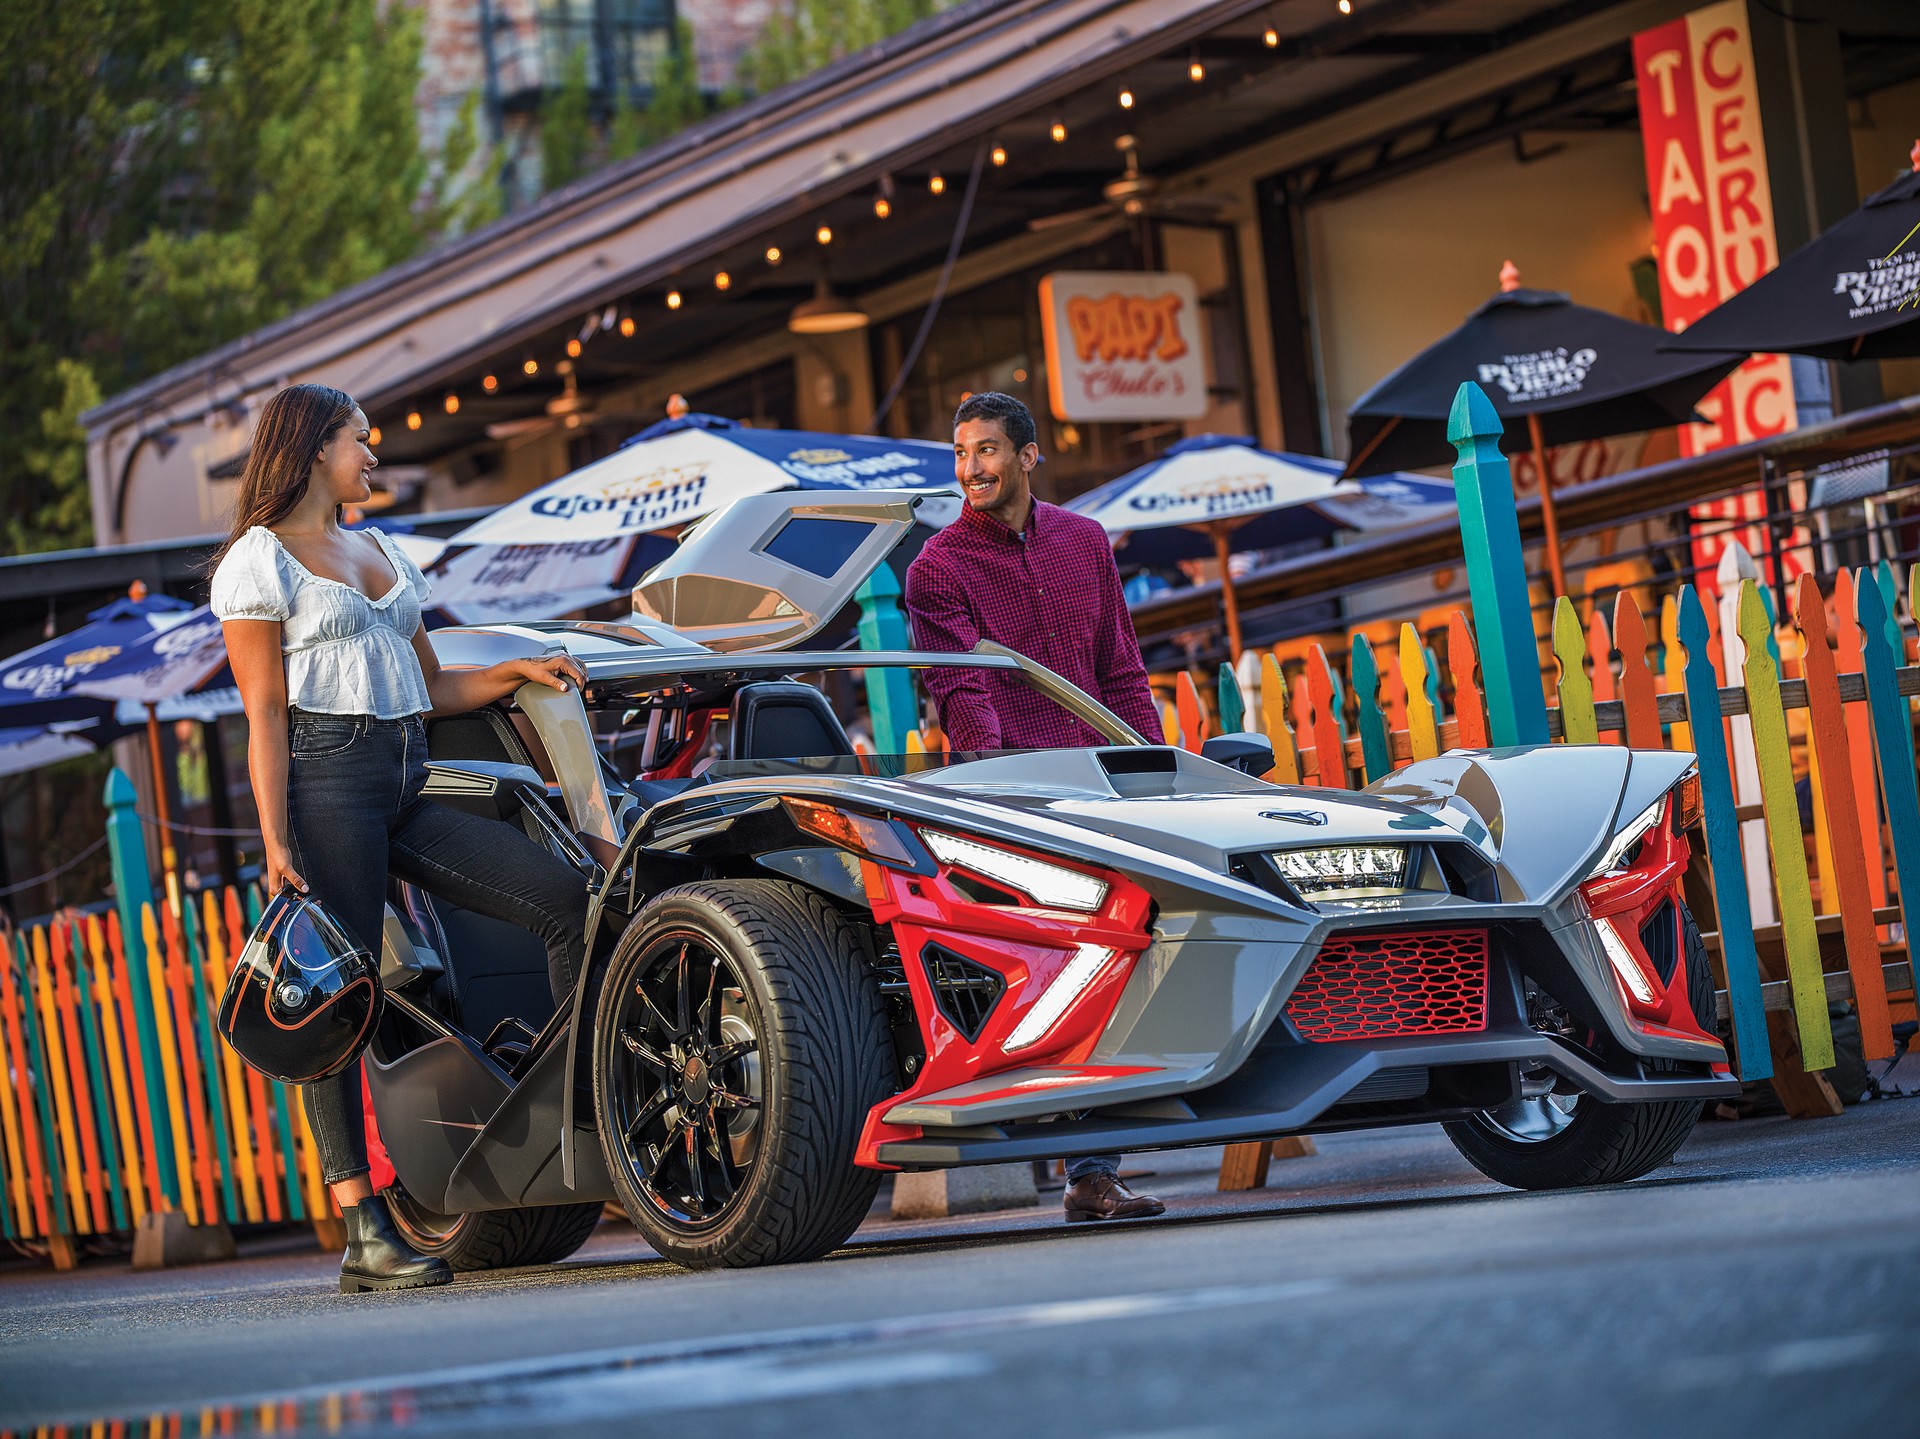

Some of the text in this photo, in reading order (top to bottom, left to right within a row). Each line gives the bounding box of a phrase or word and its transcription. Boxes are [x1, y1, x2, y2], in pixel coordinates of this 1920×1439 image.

[1065, 291, 1188, 364] PAPI
[1477, 347, 1597, 384] PUEBLO
[1498, 366, 1586, 393] VIEJO
[530, 475, 717, 520] Corona
[618, 492, 704, 529] Light
